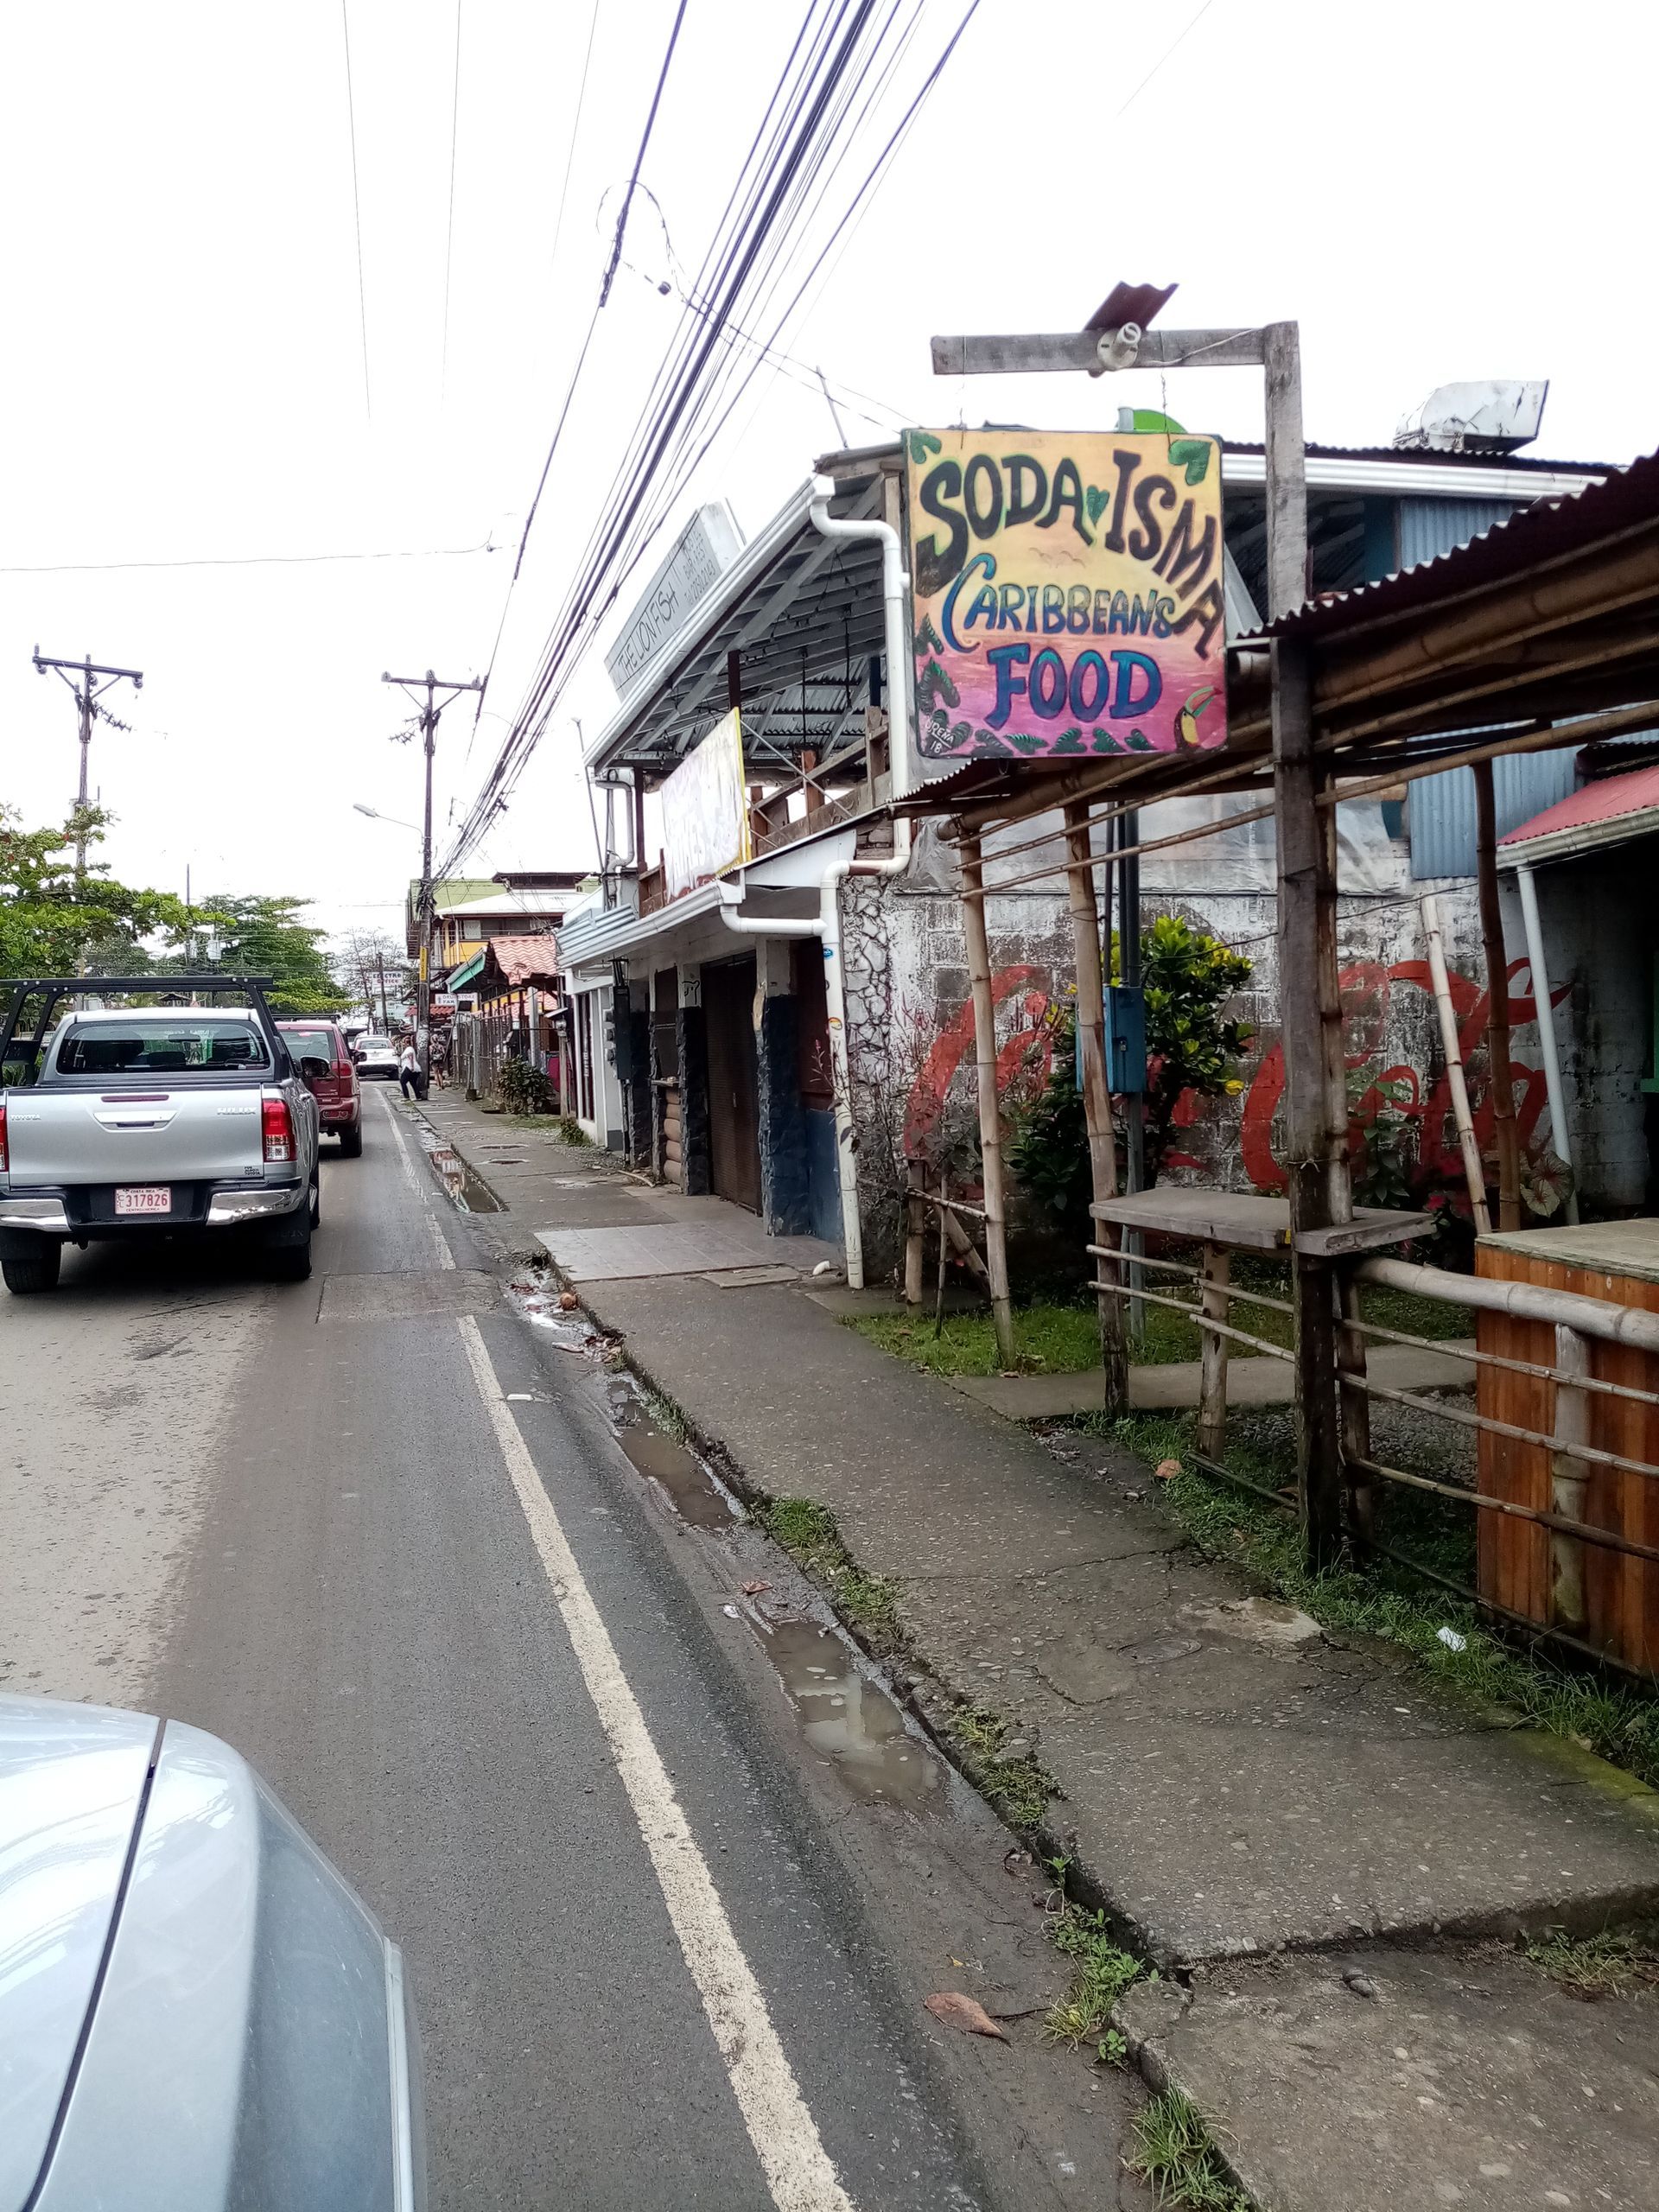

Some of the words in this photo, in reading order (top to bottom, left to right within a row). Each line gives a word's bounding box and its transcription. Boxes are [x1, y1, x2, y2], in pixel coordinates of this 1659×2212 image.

[915, 454, 1094, 598] SODA
[1105, 448, 1225, 660] ISMA
[942, 553, 1176, 653] CARIBBEANS
[618, 643, 638, 678] THE
[984, 644, 1163, 730] FOOD
[930, 740, 942, 753] 18
[125, 1193, 168, 1207] 317826
